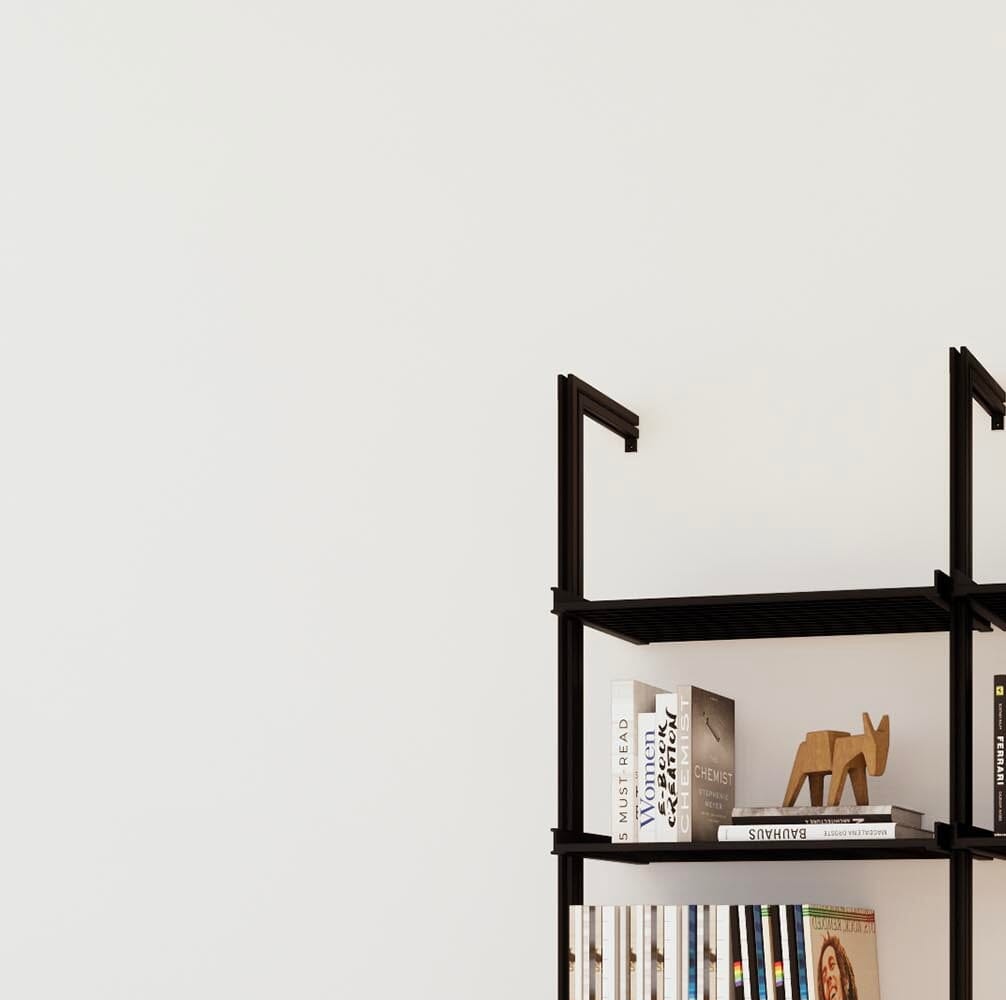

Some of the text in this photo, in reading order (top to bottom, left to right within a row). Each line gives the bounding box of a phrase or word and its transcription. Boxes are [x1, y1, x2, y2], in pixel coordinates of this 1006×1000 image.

[639, 730, 656, 828] Women
[658, 724, 667, 816] E-BOOK
[665, 707, 678, 827] CREATION
[680, 696, 690, 833] CHEMIST
[694, 765, 733, 785] CHEMIST
[996, 736, 1004, 785] FERRARI
[748, 828, 807, 840] BAUHAUS
